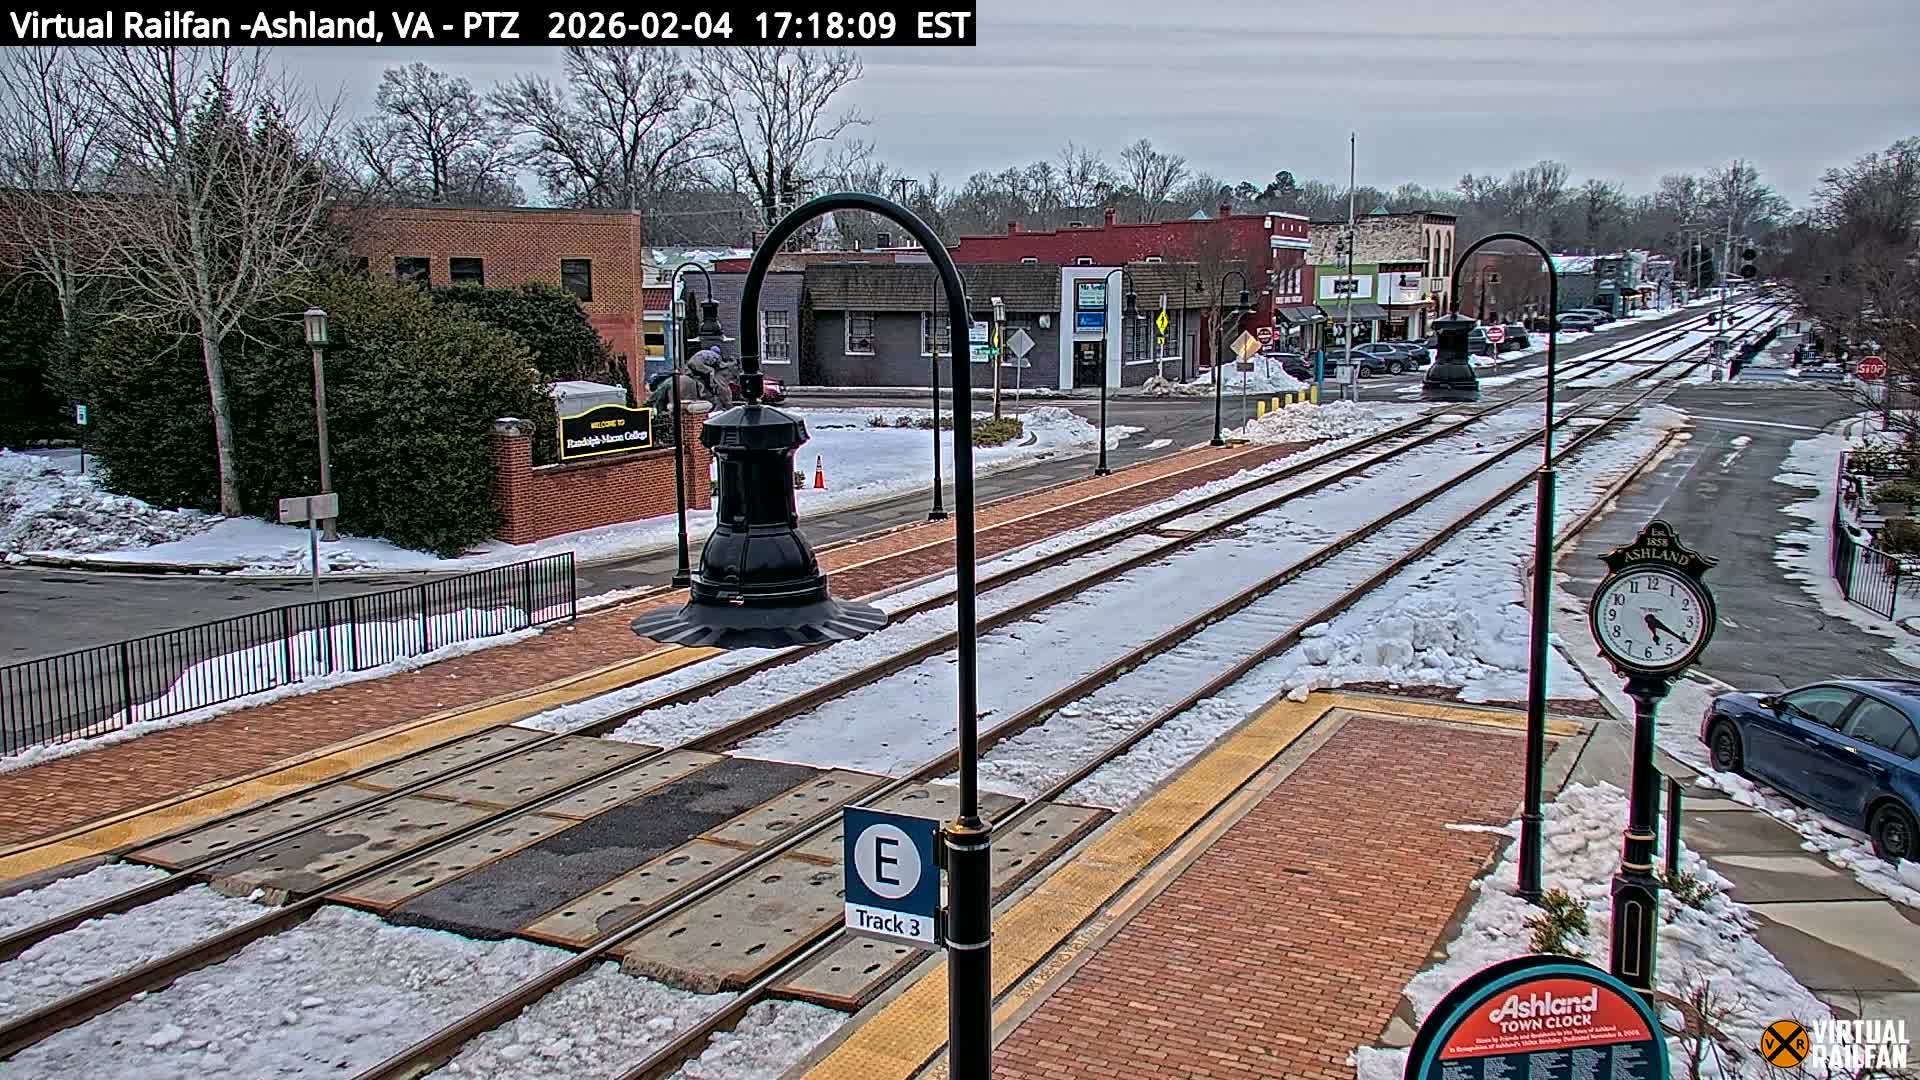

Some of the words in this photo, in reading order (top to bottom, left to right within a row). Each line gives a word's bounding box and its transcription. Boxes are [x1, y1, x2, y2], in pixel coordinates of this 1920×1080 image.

[1858, 364, 1884, 374] STOP
[624, 430, 648, 441] College
[1625, 548, 1690, 565] ASHLAND
[1630, 581, 1639, 593] 11
[1648, 577, 1659, 590] 12
[1669, 585, 1675, 597] 1
[1613, 594, 1626, 606] 10
[1681, 599, 1690, 611] 2
[1608, 608, 1616, 621] 9
[1686, 616, 1694, 628] 3
[1612, 626, 1621, 638] 8
[1624, 640, 1633, 655] 7
[1645, 646, 1652, 658] 6
[1664, 643, 1673, 655] 5
[876, 836, 900, 886] E
[856, 909, 904, 935] Track
[909, 919, 921, 936] 3
[1489, 987, 1600, 1024] Ashland
[1499, 1018, 1543, 1033] TOWN
[1545, 1012, 1592, 1029] CLOCK
